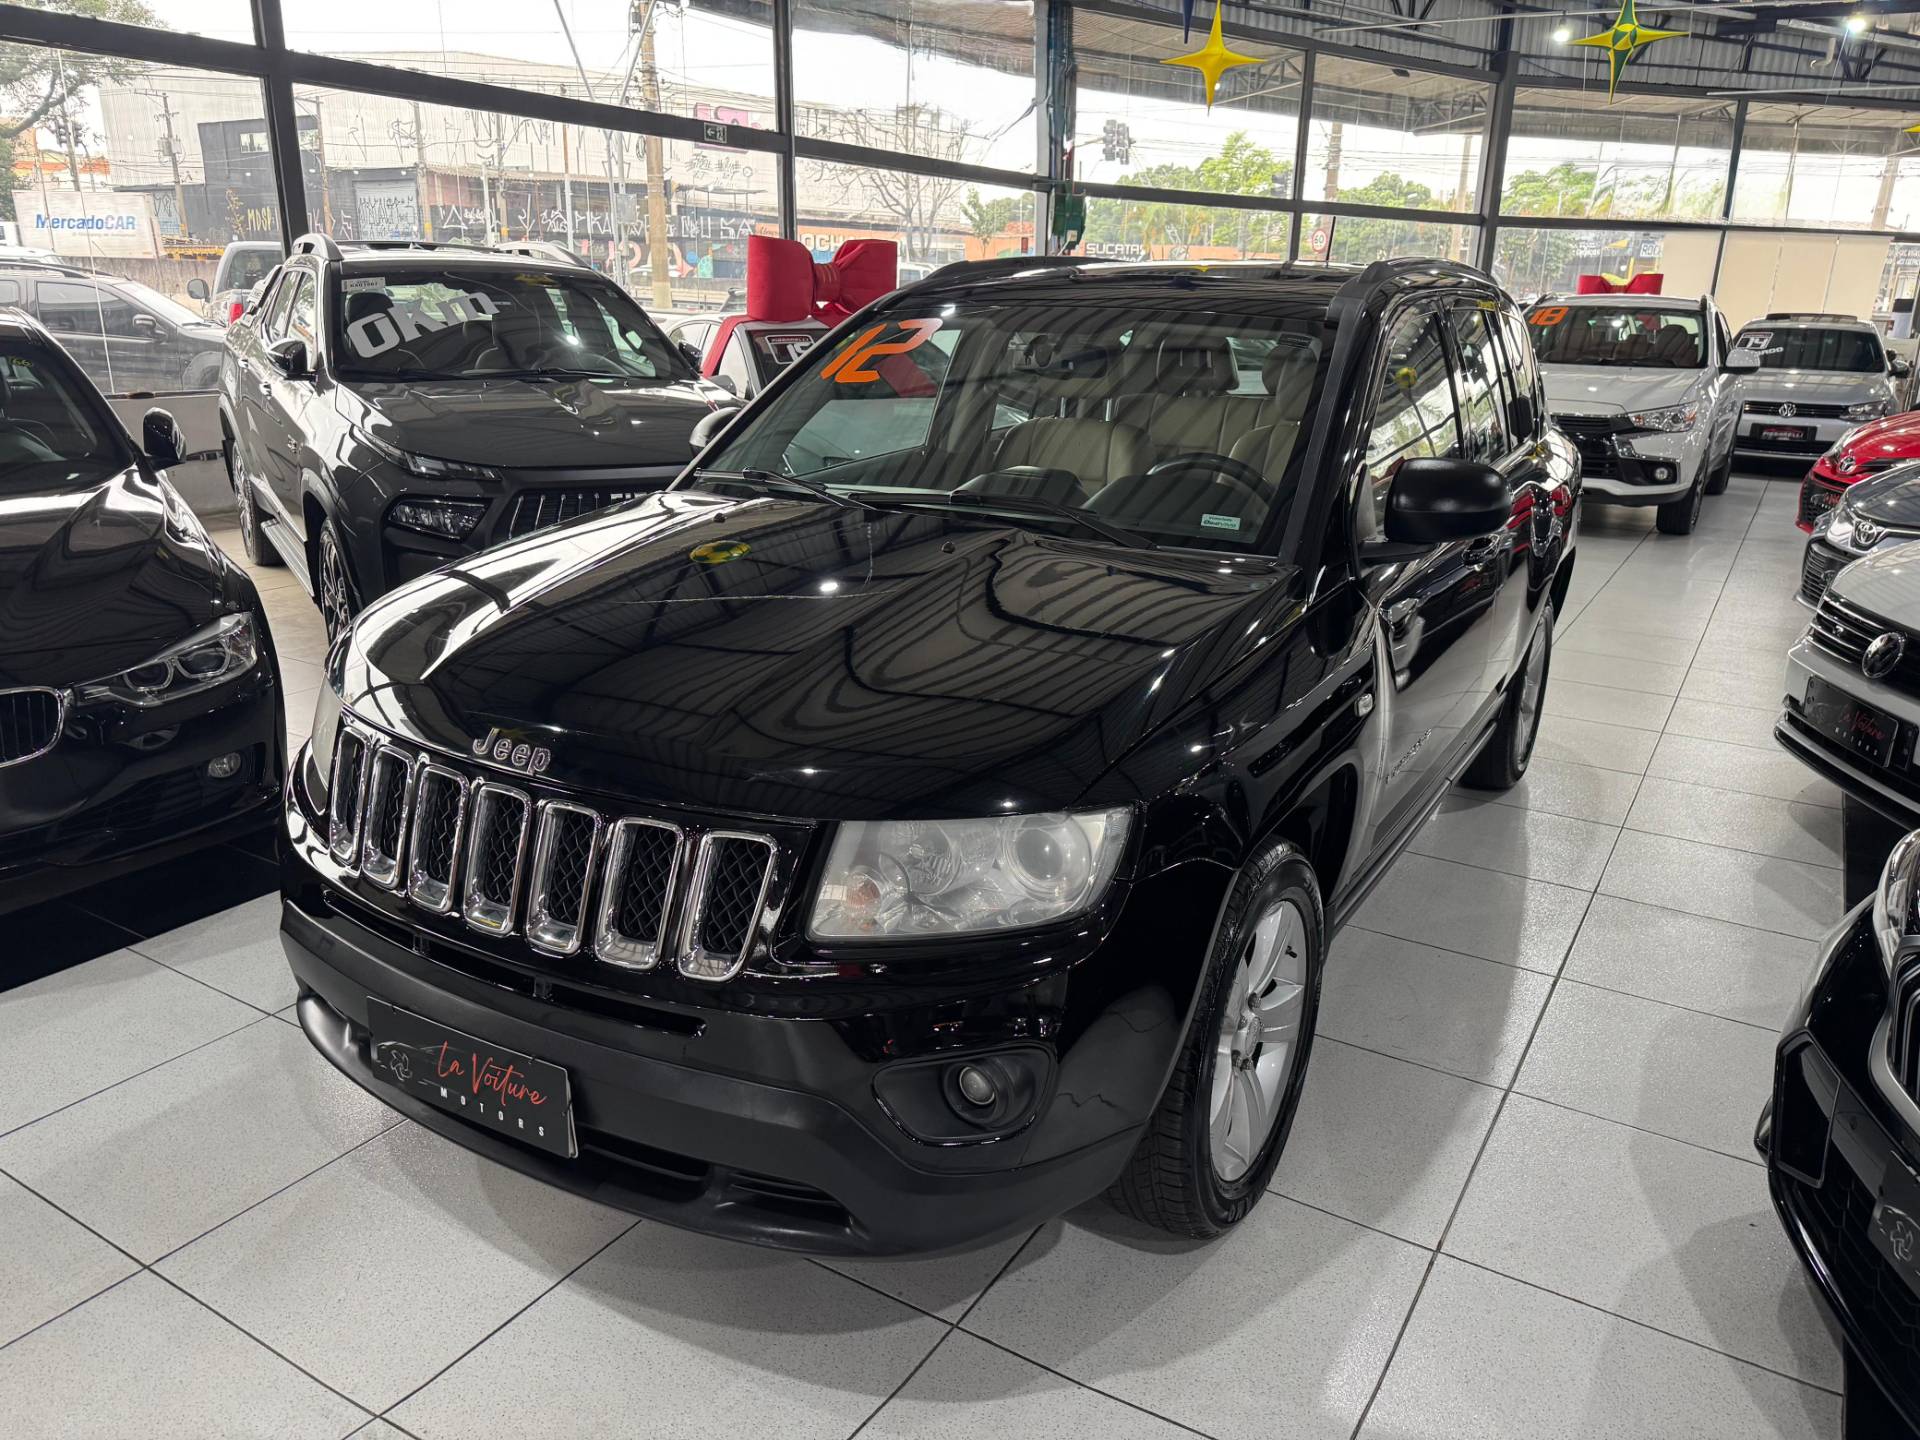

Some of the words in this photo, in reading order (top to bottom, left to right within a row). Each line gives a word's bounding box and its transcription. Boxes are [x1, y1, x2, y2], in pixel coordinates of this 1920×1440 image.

[35, 213, 136, 230] MercadoCAR
[1528, 306, 1569, 326] 18
[820, 318, 943, 383] 12
[472, 727, 551, 776] Jeep
[436, 1040, 465, 1078] La
[472, 1053, 548, 1107] Voiture
[440, 1087, 545, 1137] MOTORS
